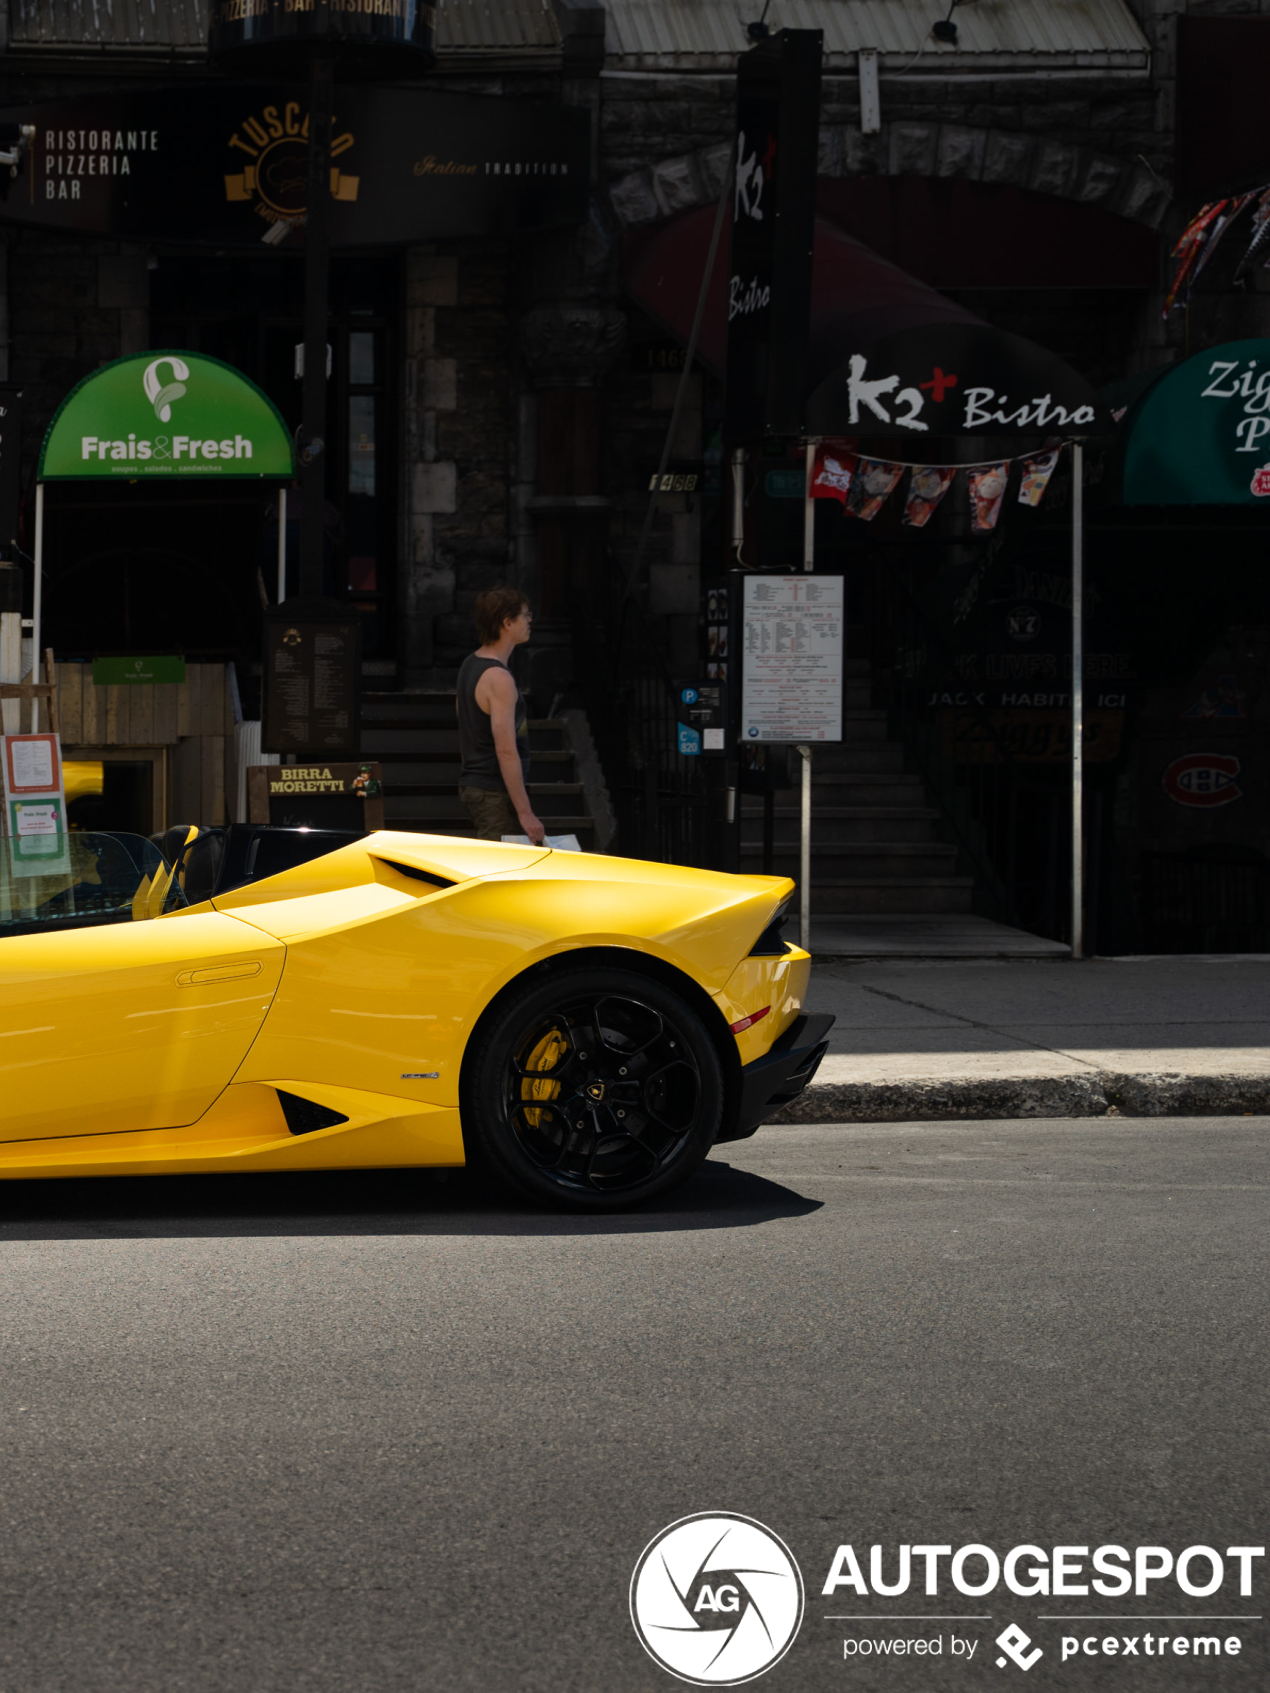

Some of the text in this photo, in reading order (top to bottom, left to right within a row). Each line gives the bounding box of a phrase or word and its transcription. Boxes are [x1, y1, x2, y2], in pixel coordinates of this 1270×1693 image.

[228, 101, 355, 158] TUSCO
[46, 130, 159, 151] RISTORANTE
[46, 155, 131, 175] PIZZERIA
[413, 154, 568, 177] Italian TRADITION
[46, 179, 81, 200] BAR
[728, 274, 770, 321] Bistro
[962, 386, 1095, 429] Bistro
[112, 464, 222, 474] soupes salades sandwiches
[928, 693, 1126, 707] JACK HABIT ICI
[281, 768, 333, 781] BIRRA
[270, 780, 345, 793] MORETTI
